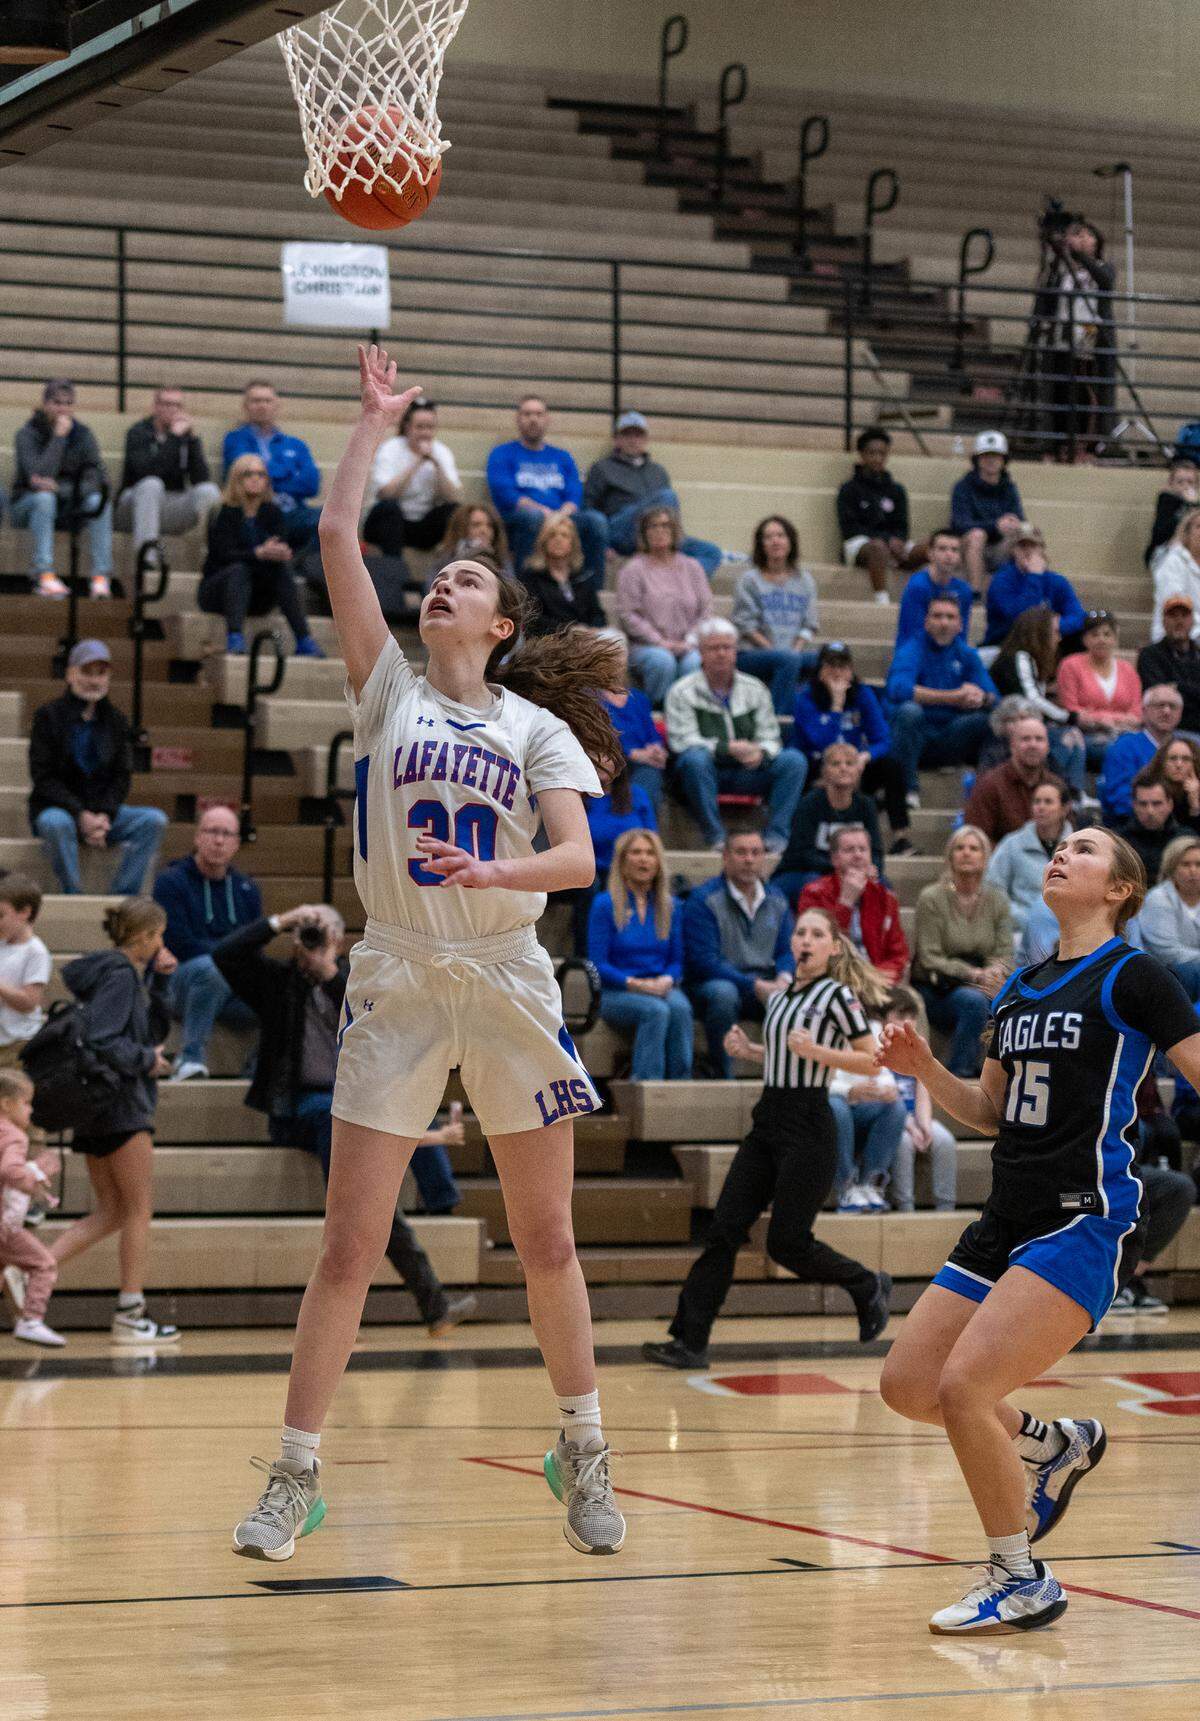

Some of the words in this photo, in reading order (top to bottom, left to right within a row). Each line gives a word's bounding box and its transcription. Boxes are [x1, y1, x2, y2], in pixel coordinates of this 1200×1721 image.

[393, 740, 522, 811] LAFAYETTE
[407, 799, 499, 888] 30
[534, 1079, 595, 1127] LHS
[1006, 1060, 1050, 1126] 15
